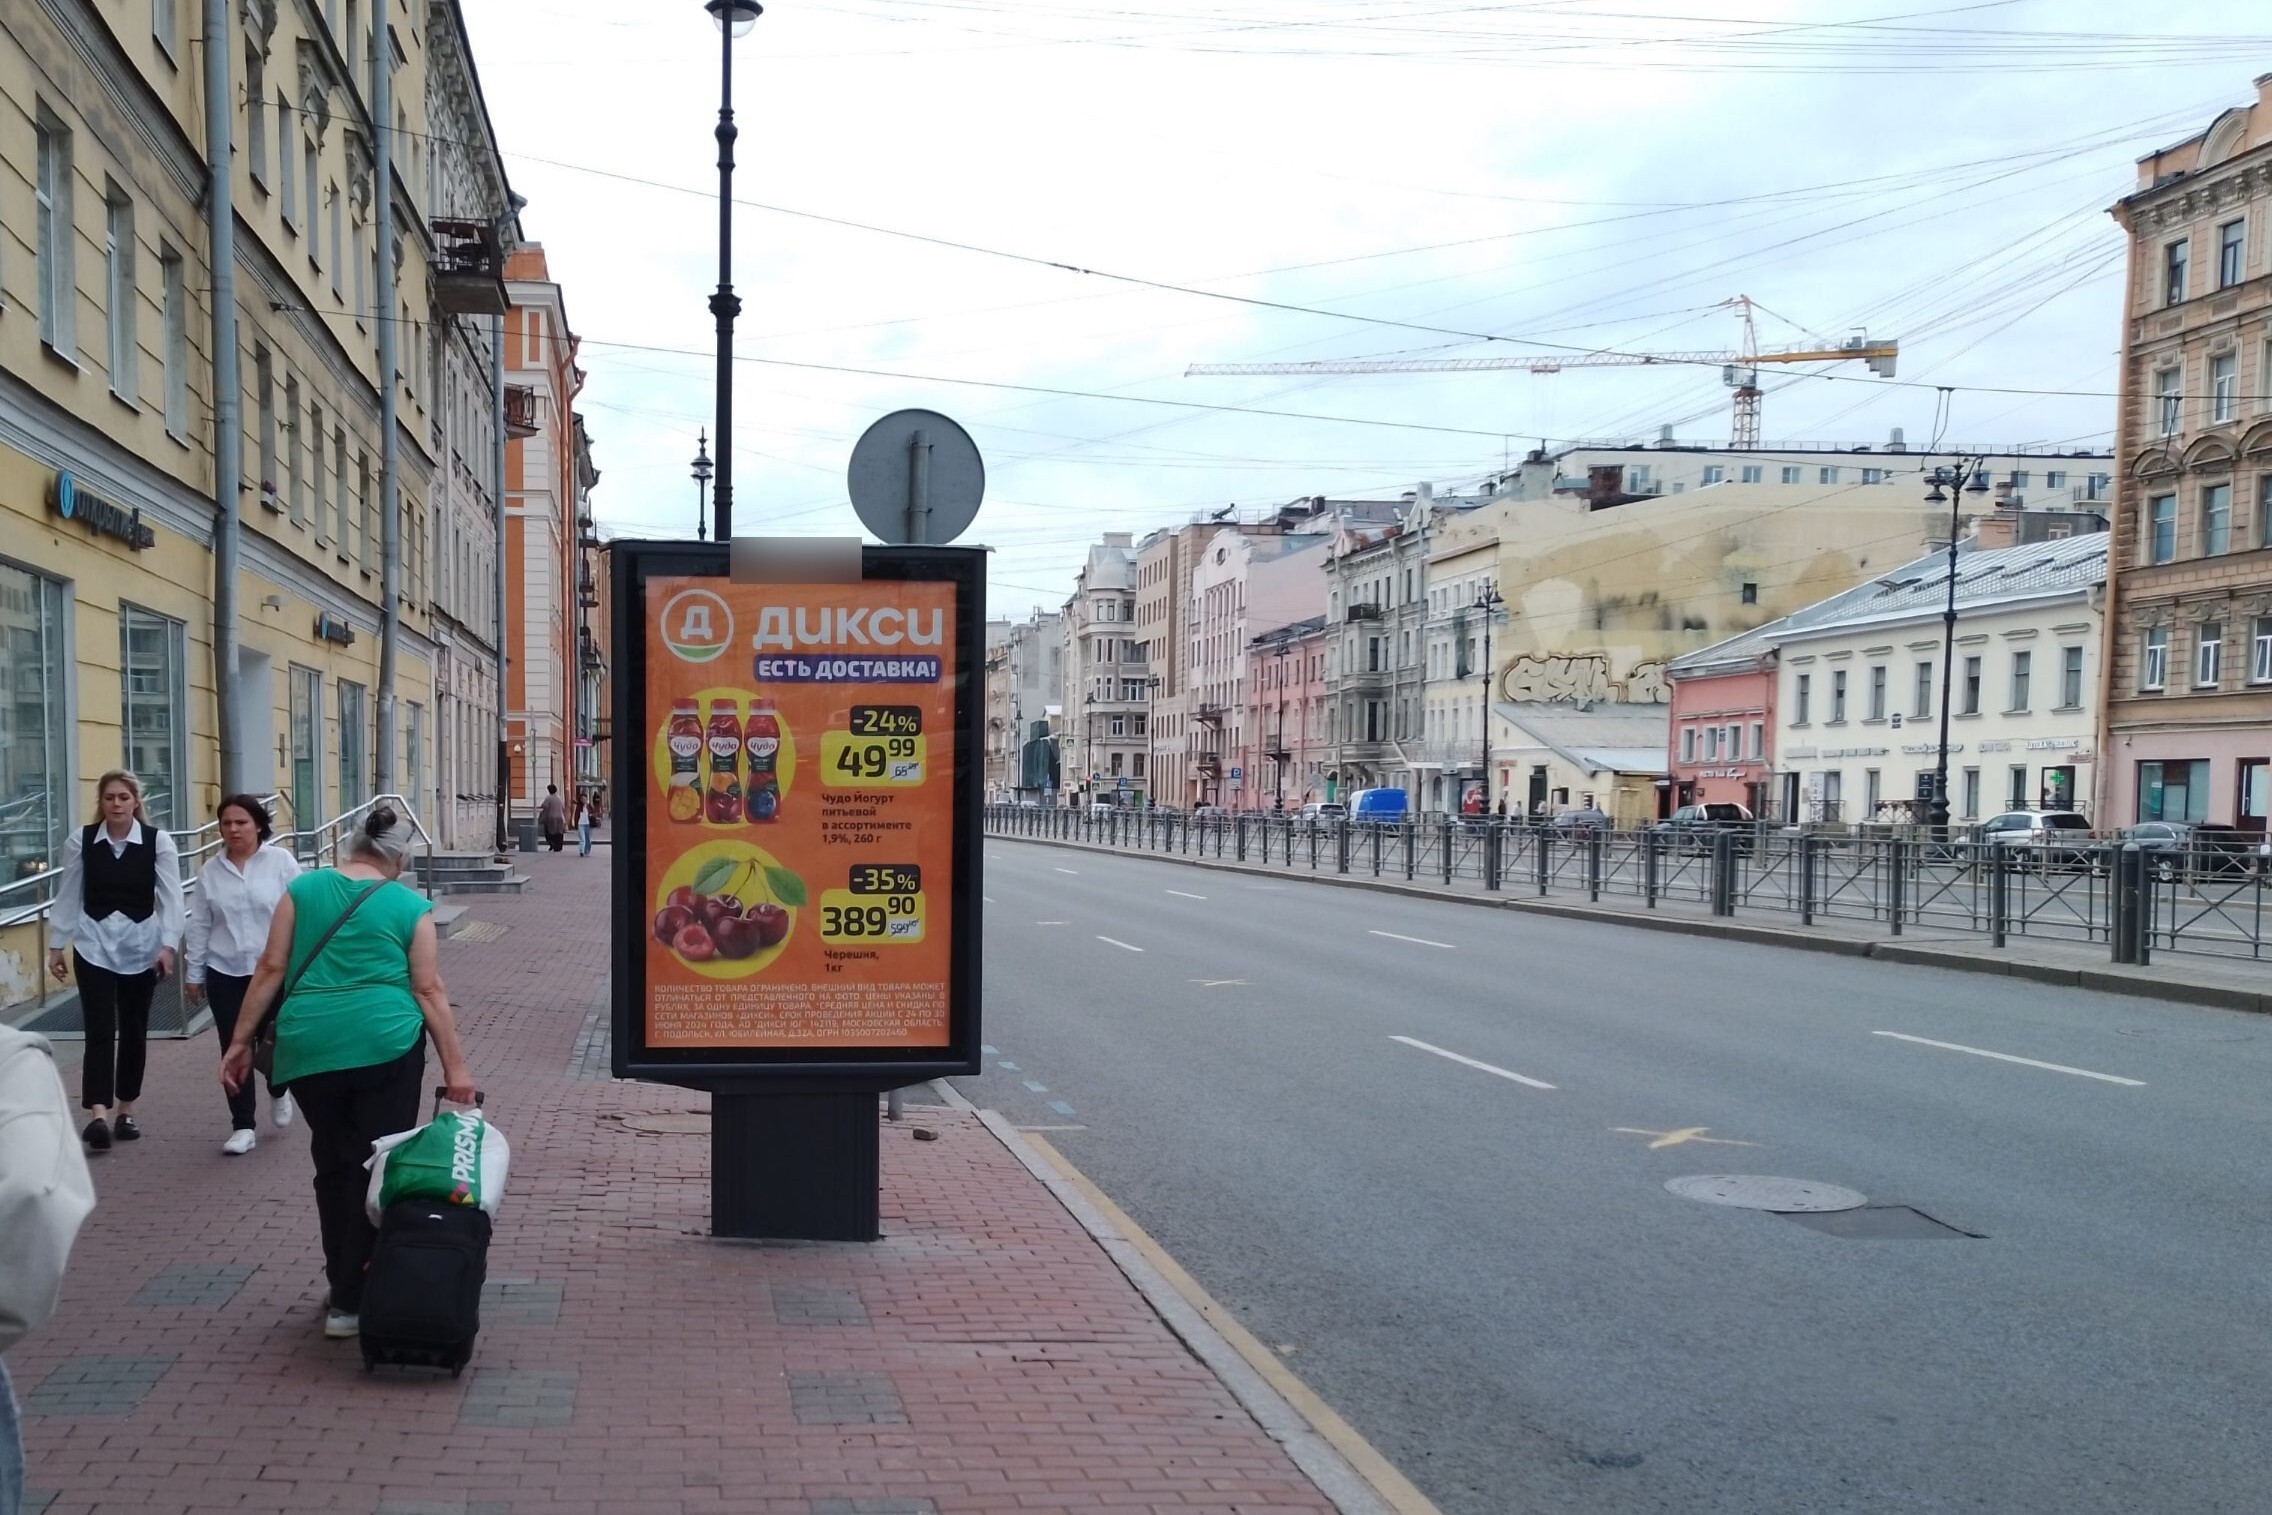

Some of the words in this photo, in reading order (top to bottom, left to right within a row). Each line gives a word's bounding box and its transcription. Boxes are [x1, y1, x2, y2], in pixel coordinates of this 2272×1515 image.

[681, 606, 712, 639] Д
[759, 660, 811, 677] ЕСТЬ
[815, 660, 937, 679] ДОСТАВКА!
[853, 710, 917, 732] -24%
[822, 794, 851, 804] Чудо
[854, 790, 894, 805] Йогурт
[822, 806, 876, 816] питьевой
[822, 822, 829, 830] в
[831, 821, 912, 832] ассортименте
[854, 833, 874, 843] 260
[876, 835, 882, 843] г
[853, 869, 916, 890] -35%
[824, 950, 879, 960] Черешня,
[824, 963, 844, 973] 1кг
